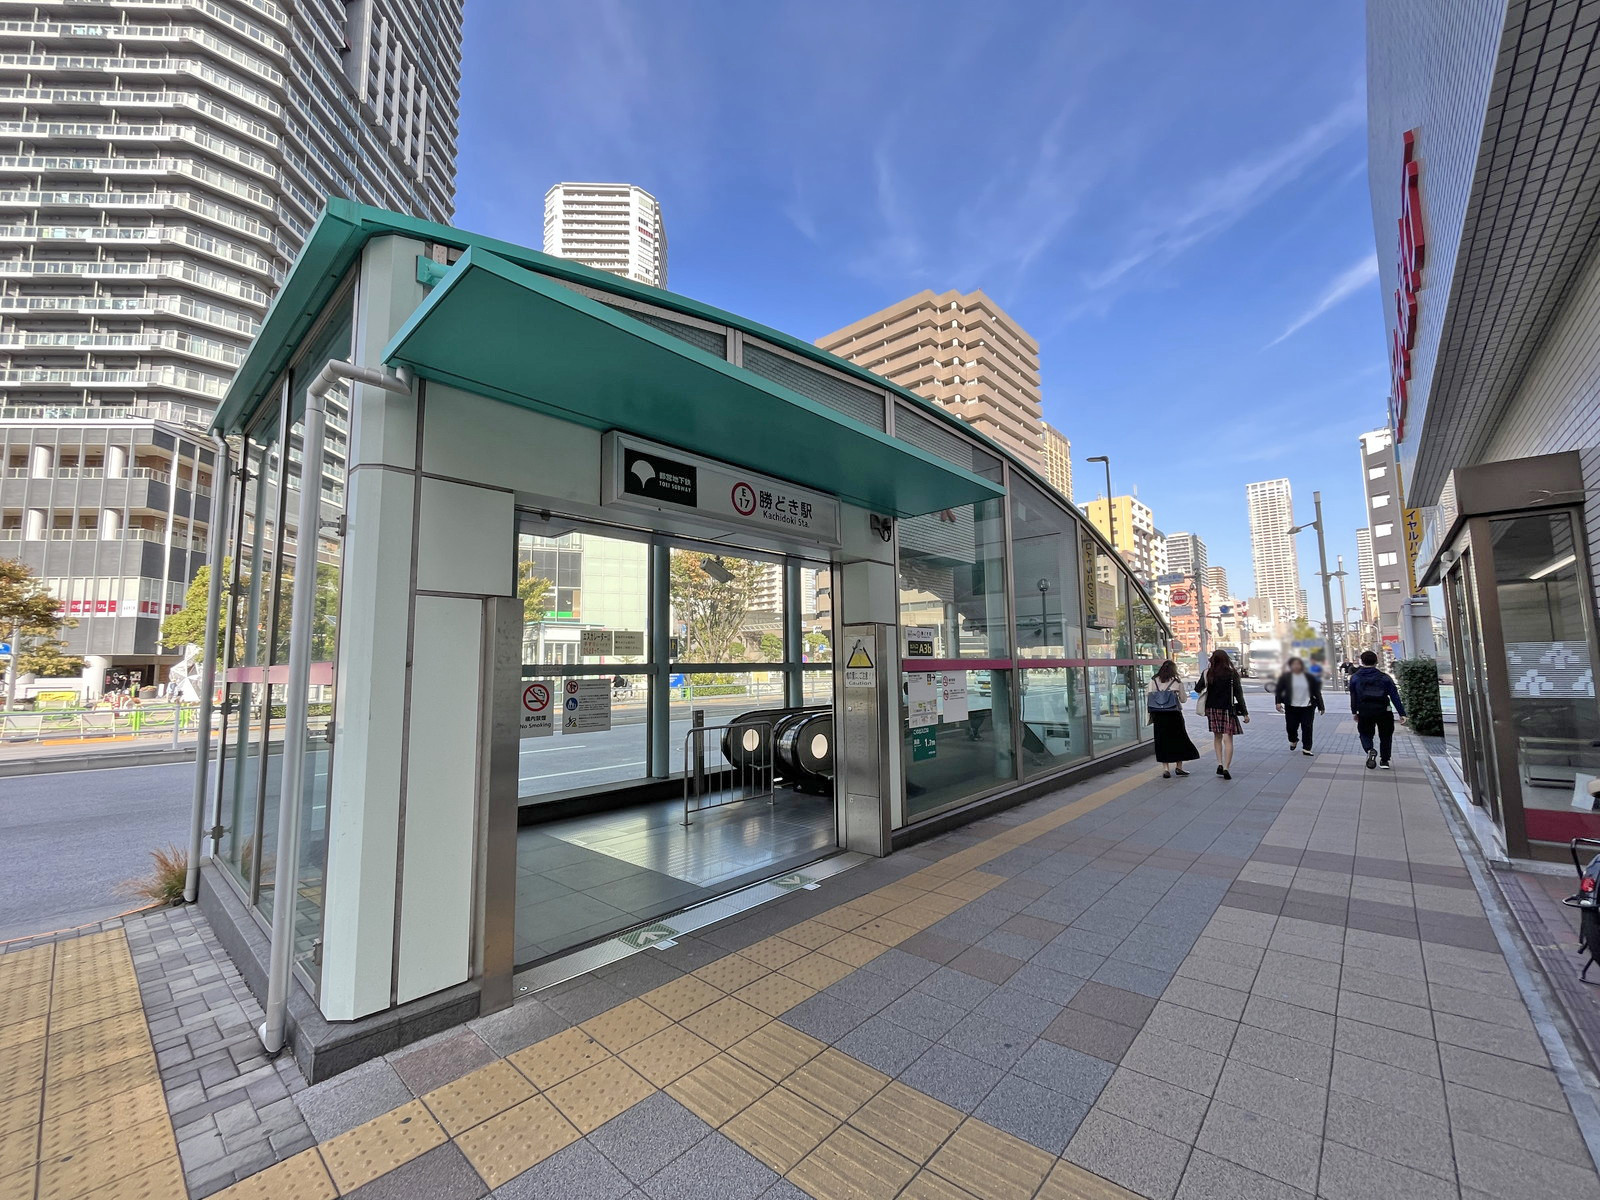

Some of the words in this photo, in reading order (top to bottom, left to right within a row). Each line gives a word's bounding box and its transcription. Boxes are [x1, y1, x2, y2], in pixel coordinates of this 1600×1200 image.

[659, 480, 670, 488] TOEI
[672, 484, 691, 492] SUBWAY
[742, 488, 747, 497] E
[739, 497, 750, 508] 17
[760, 490, 812, 519] 勝どき駅
[763, 510, 796, 525] Kachidoki
[919, 643, 932, 654] A3b
